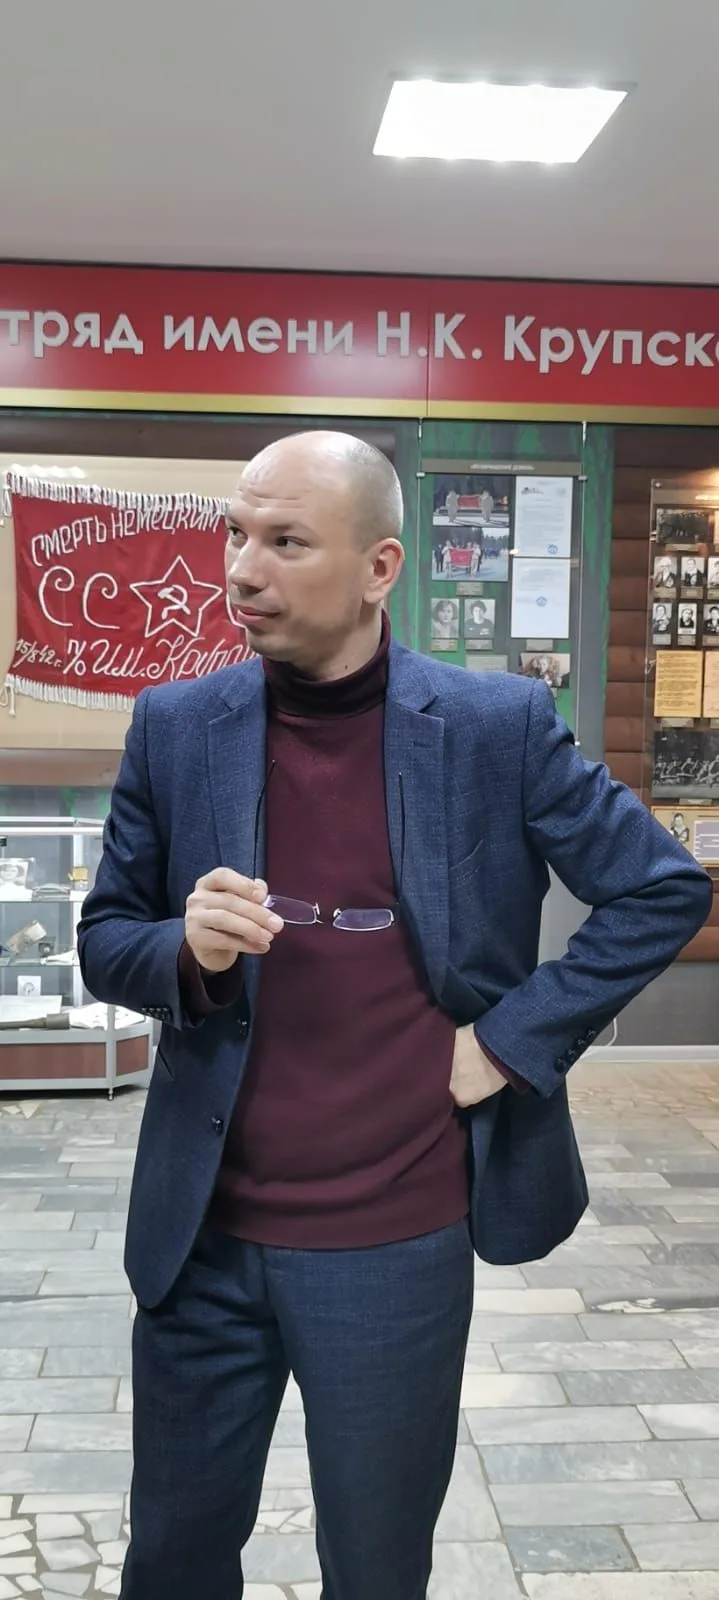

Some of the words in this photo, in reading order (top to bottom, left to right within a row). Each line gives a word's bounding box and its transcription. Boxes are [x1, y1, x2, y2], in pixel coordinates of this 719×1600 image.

[164, 315, 354, 357] имени
[376, 310, 482, 361] Н.К.
[504, 315, 719, 376] Крупск
